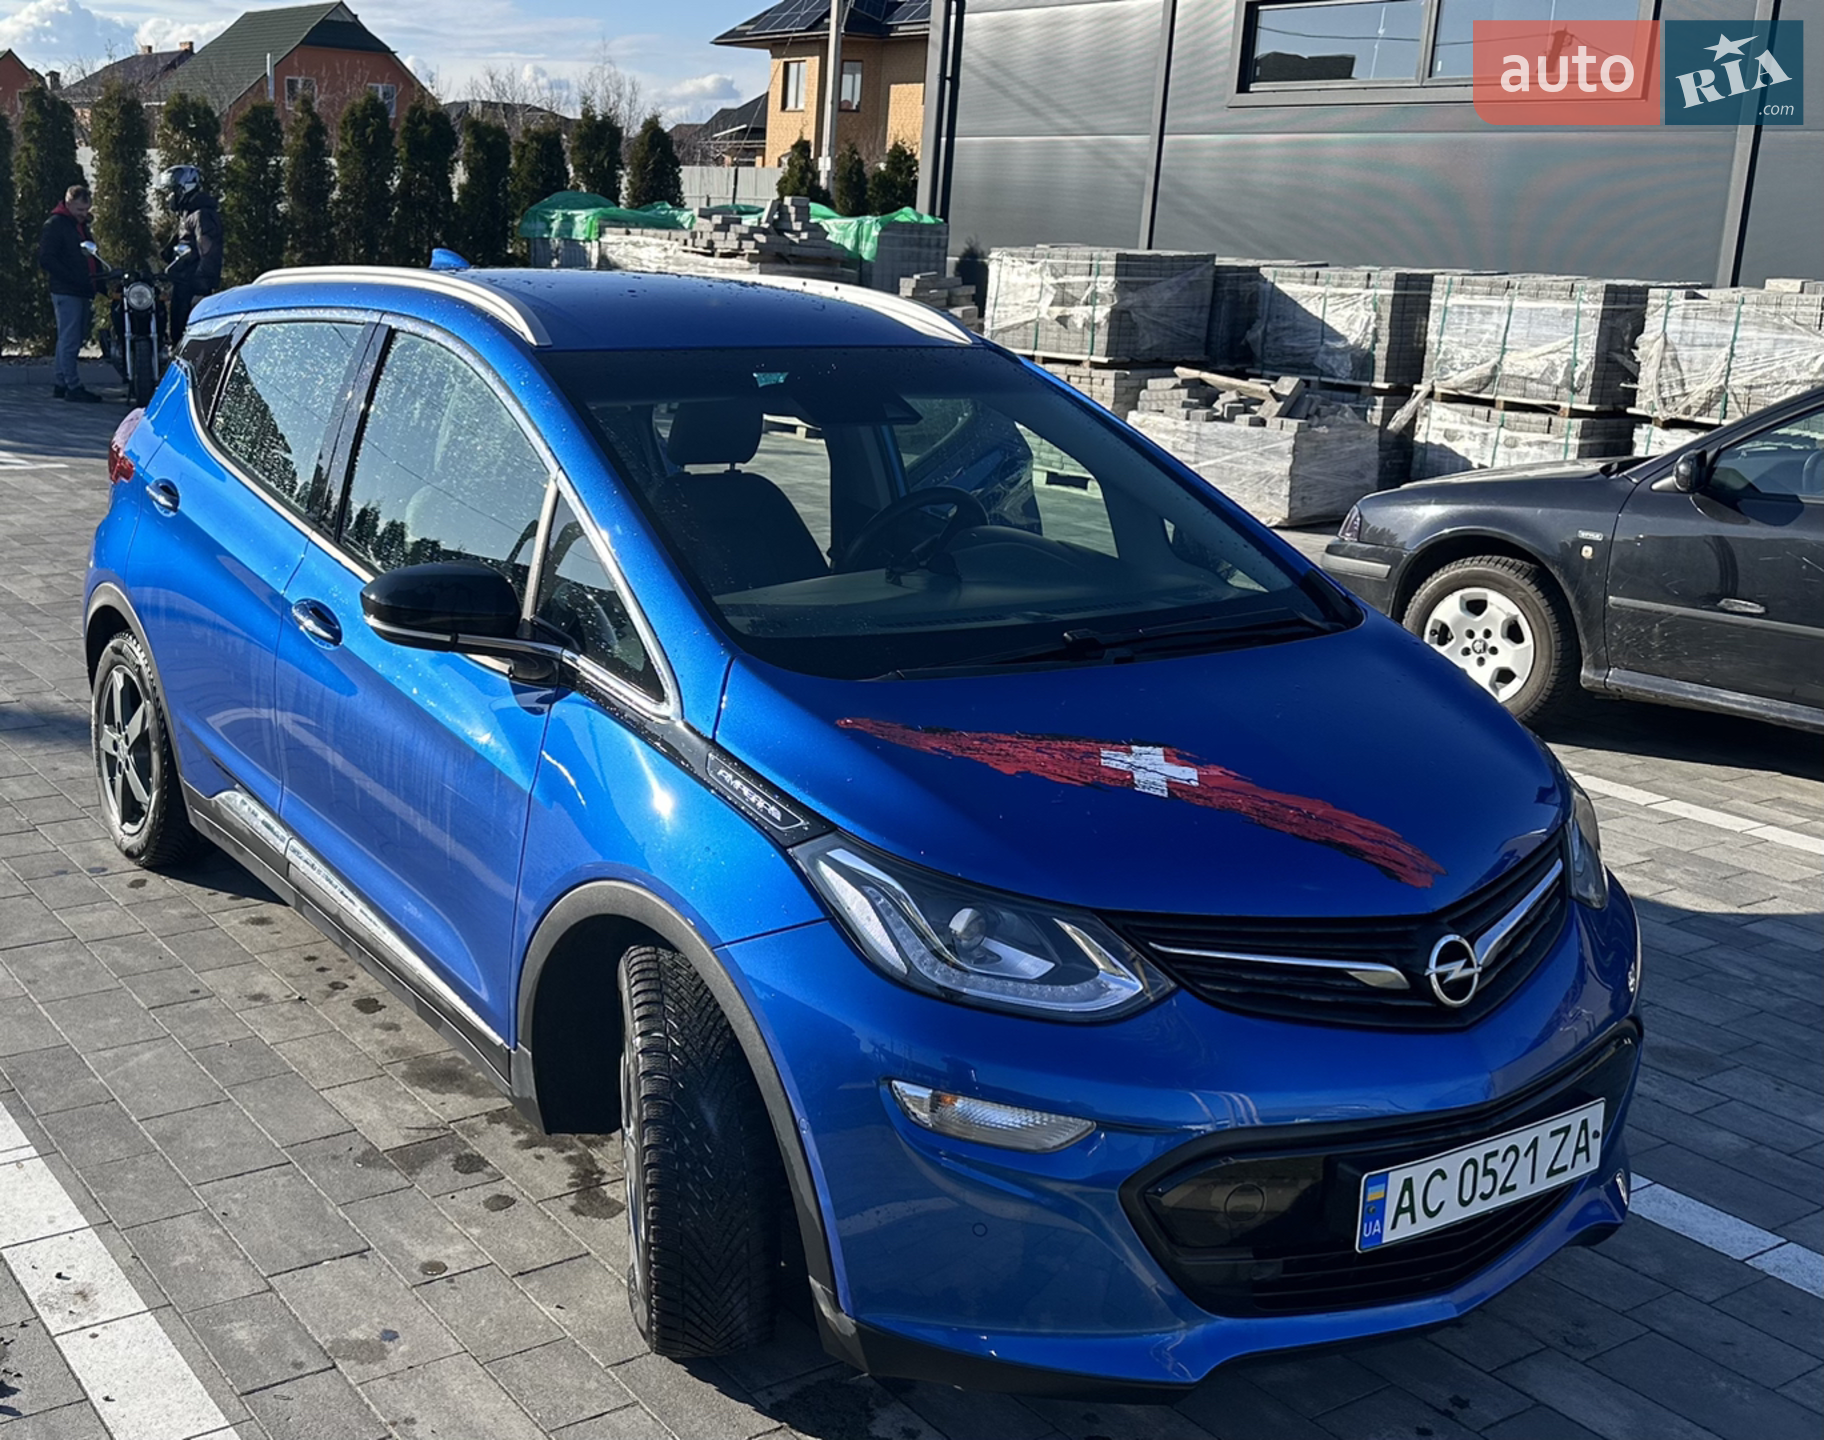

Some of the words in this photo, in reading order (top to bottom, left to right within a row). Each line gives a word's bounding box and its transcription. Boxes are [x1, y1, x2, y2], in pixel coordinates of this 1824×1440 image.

[1390, 1168, 1448, 1231] AC
[1457, 1136, 1539, 1208] 0521
[1546, 1118, 1591, 1179] ZA
[1363, 1219, 1382, 1238] UA
